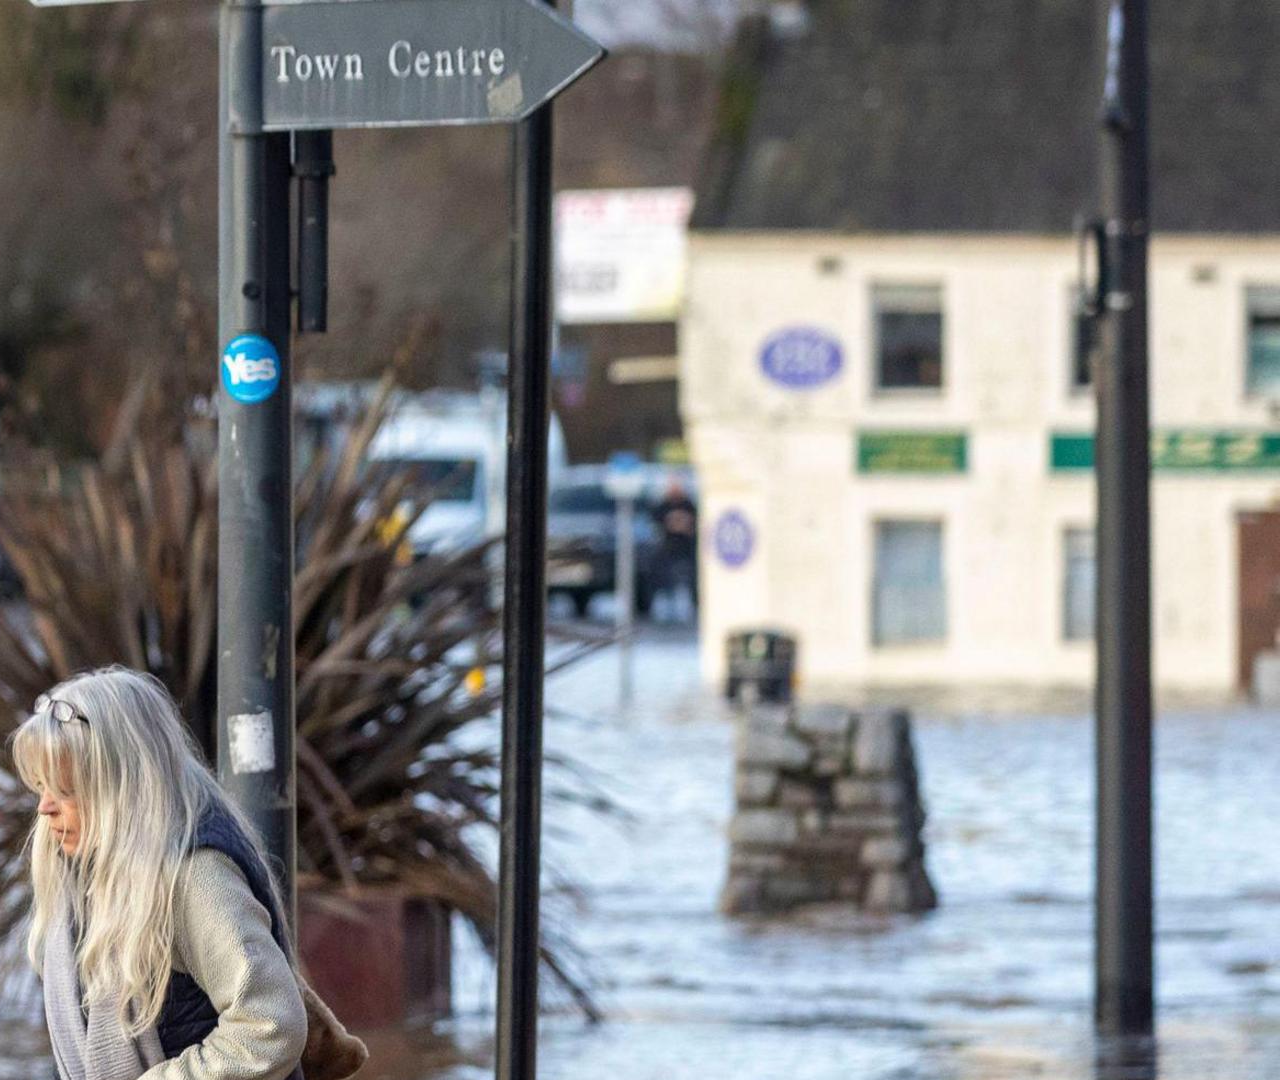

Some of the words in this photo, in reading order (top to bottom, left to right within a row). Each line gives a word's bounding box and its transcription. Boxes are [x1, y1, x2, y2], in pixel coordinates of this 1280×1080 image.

[271, 45, 364, 82] Town
[388, 40, 505, 78] Centre
[224, 353, 276, 385] Yes
